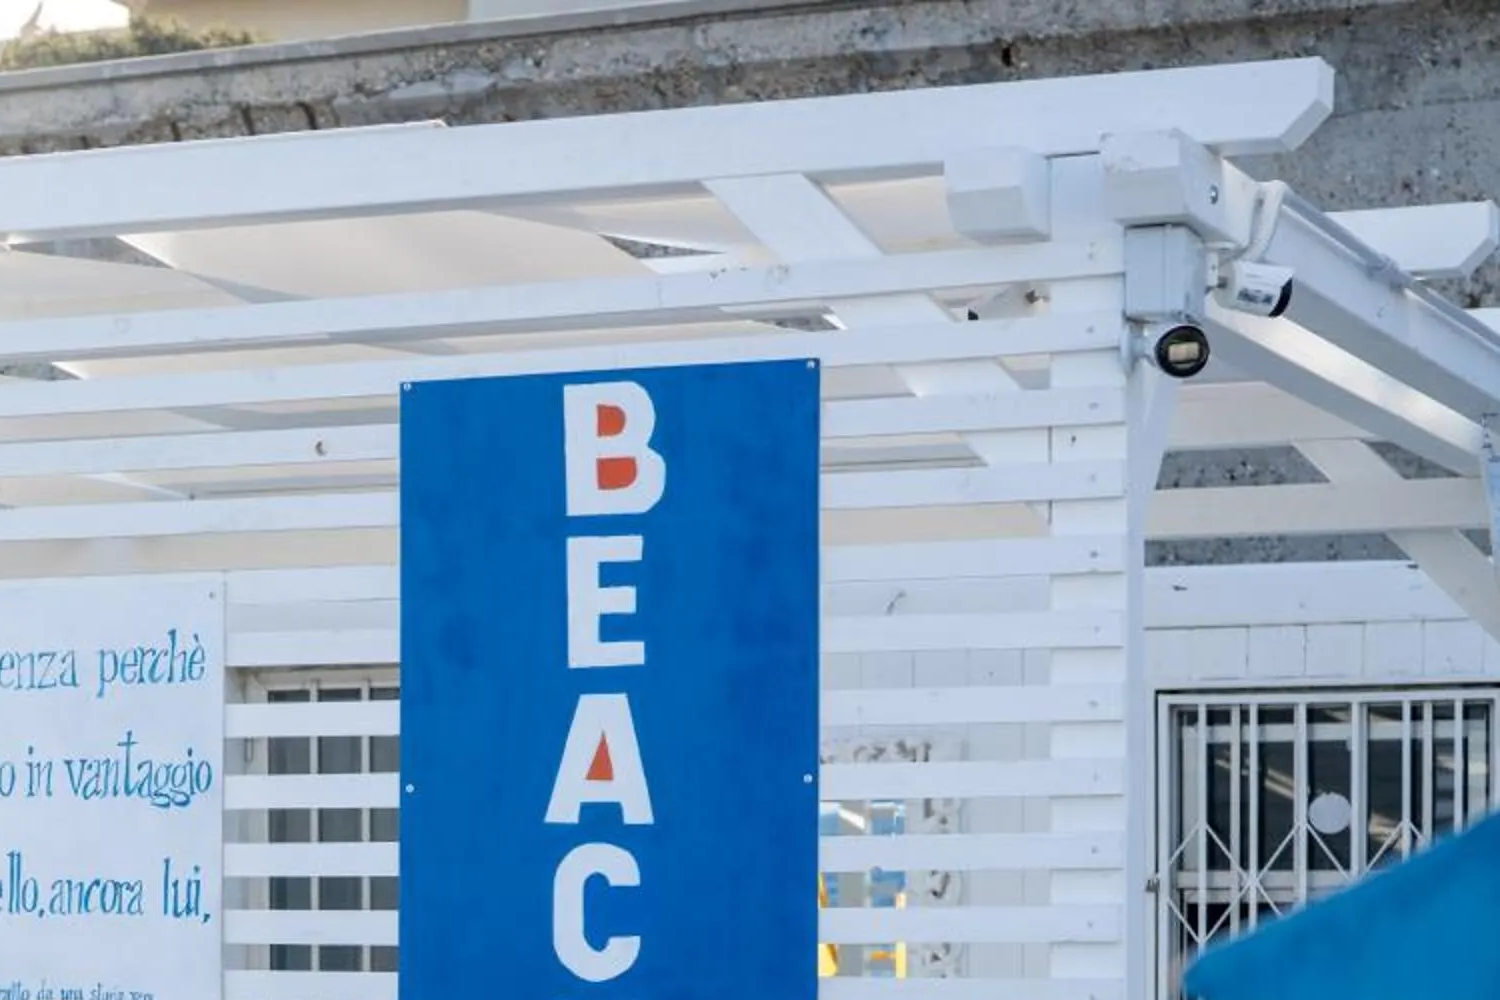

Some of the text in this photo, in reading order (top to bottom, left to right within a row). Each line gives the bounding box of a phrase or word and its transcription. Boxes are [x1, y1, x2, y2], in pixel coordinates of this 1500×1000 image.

[97, 628, 207, 698] perchè
[26, 745, 54, 797] in
[63, 729, 213, 808] vantaggio
[162, 856, 211, 925] lui,
